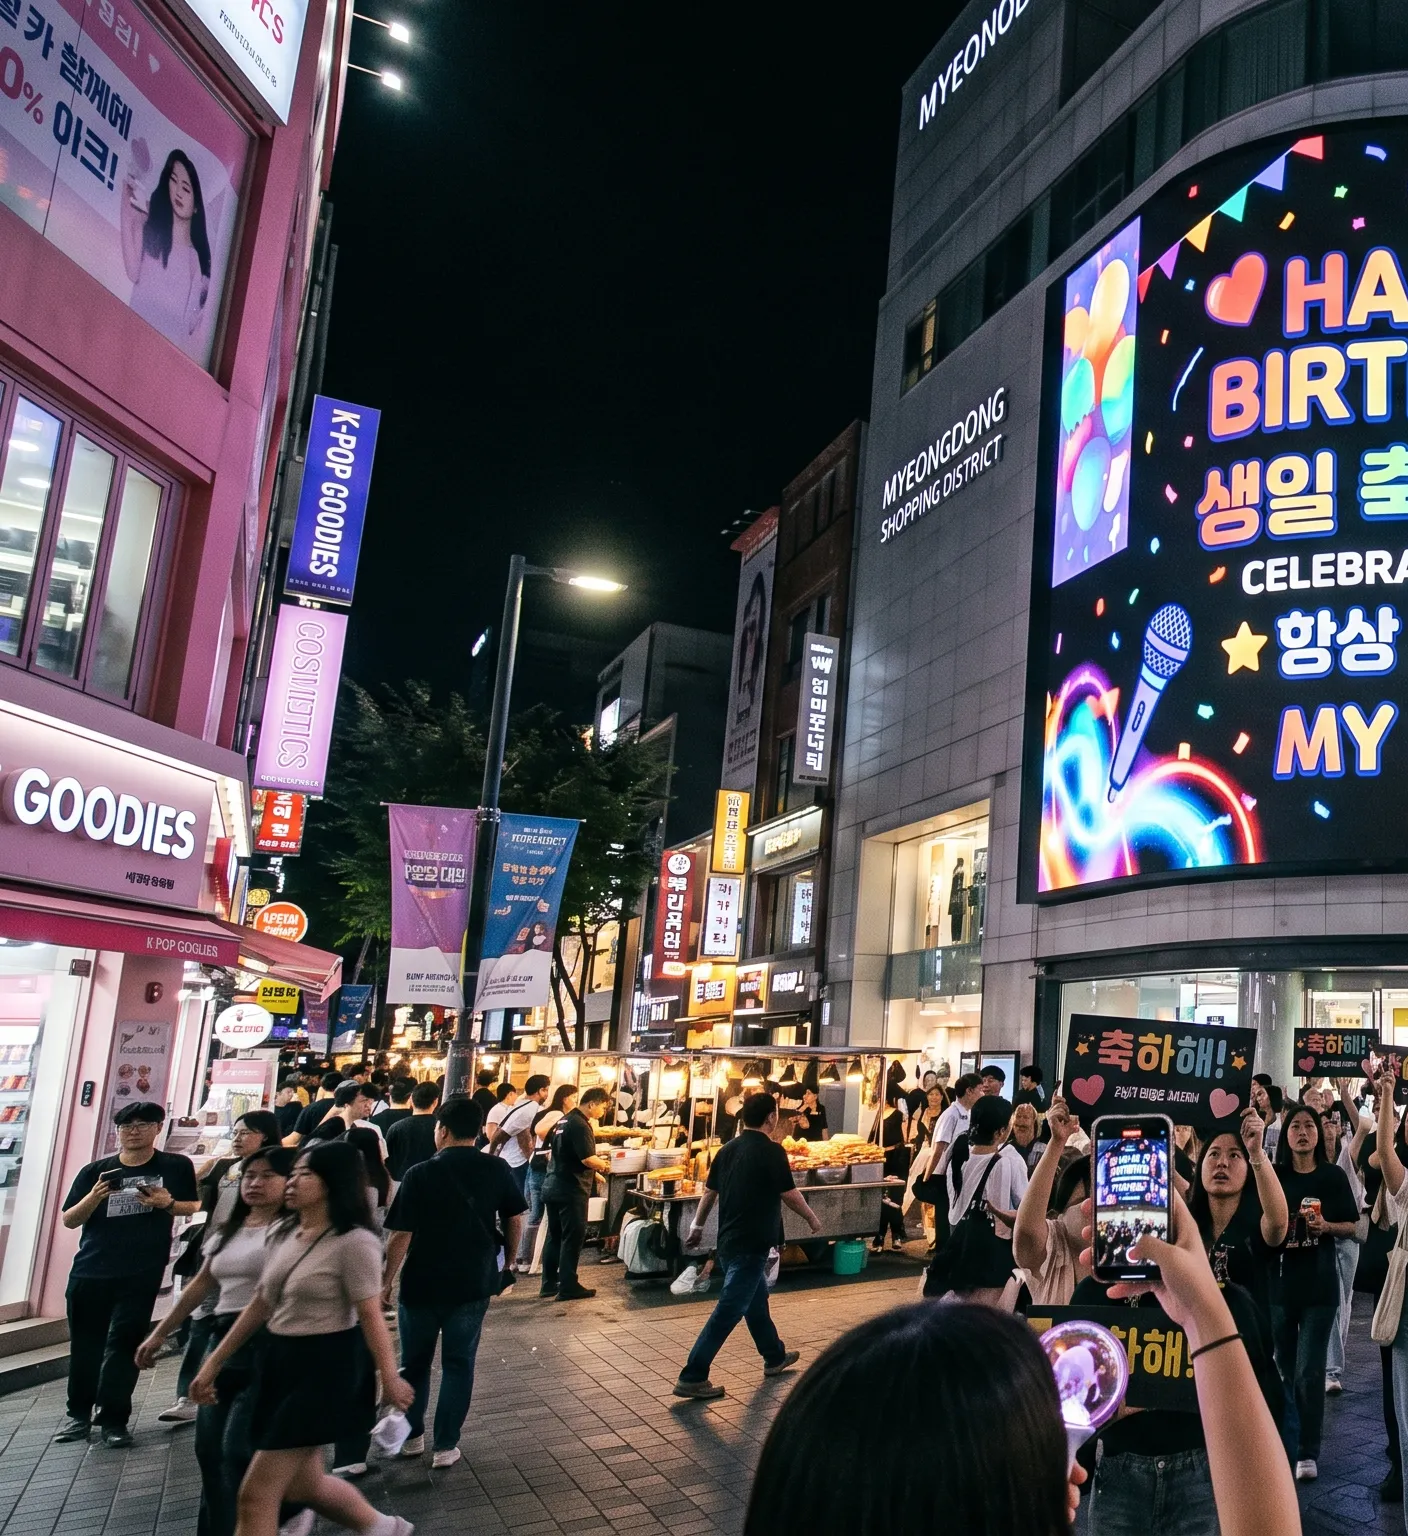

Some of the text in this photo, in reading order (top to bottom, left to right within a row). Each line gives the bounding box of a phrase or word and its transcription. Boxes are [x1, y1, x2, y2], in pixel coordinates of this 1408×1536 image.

[324, 408, 361, 480] K-POP
[882, 387, 1005, 510] MYEONGDONG
[880, 434, 1002, 543] SHOPPING DISTRICT
[1196, 448, 1337, 551] 생일
[309, 481, 349, 578] GOODIES
[1275, 603, 1401, 678] 항상
[1273, 701, 1397, 780] MY
[14, 767, 198, 861] GOODIES
[155, 938, 176, 951] POP
[1098, 1029, 1228, 1079] 축하해!
[1307, 1033, 1366, 1055] 축하해!
